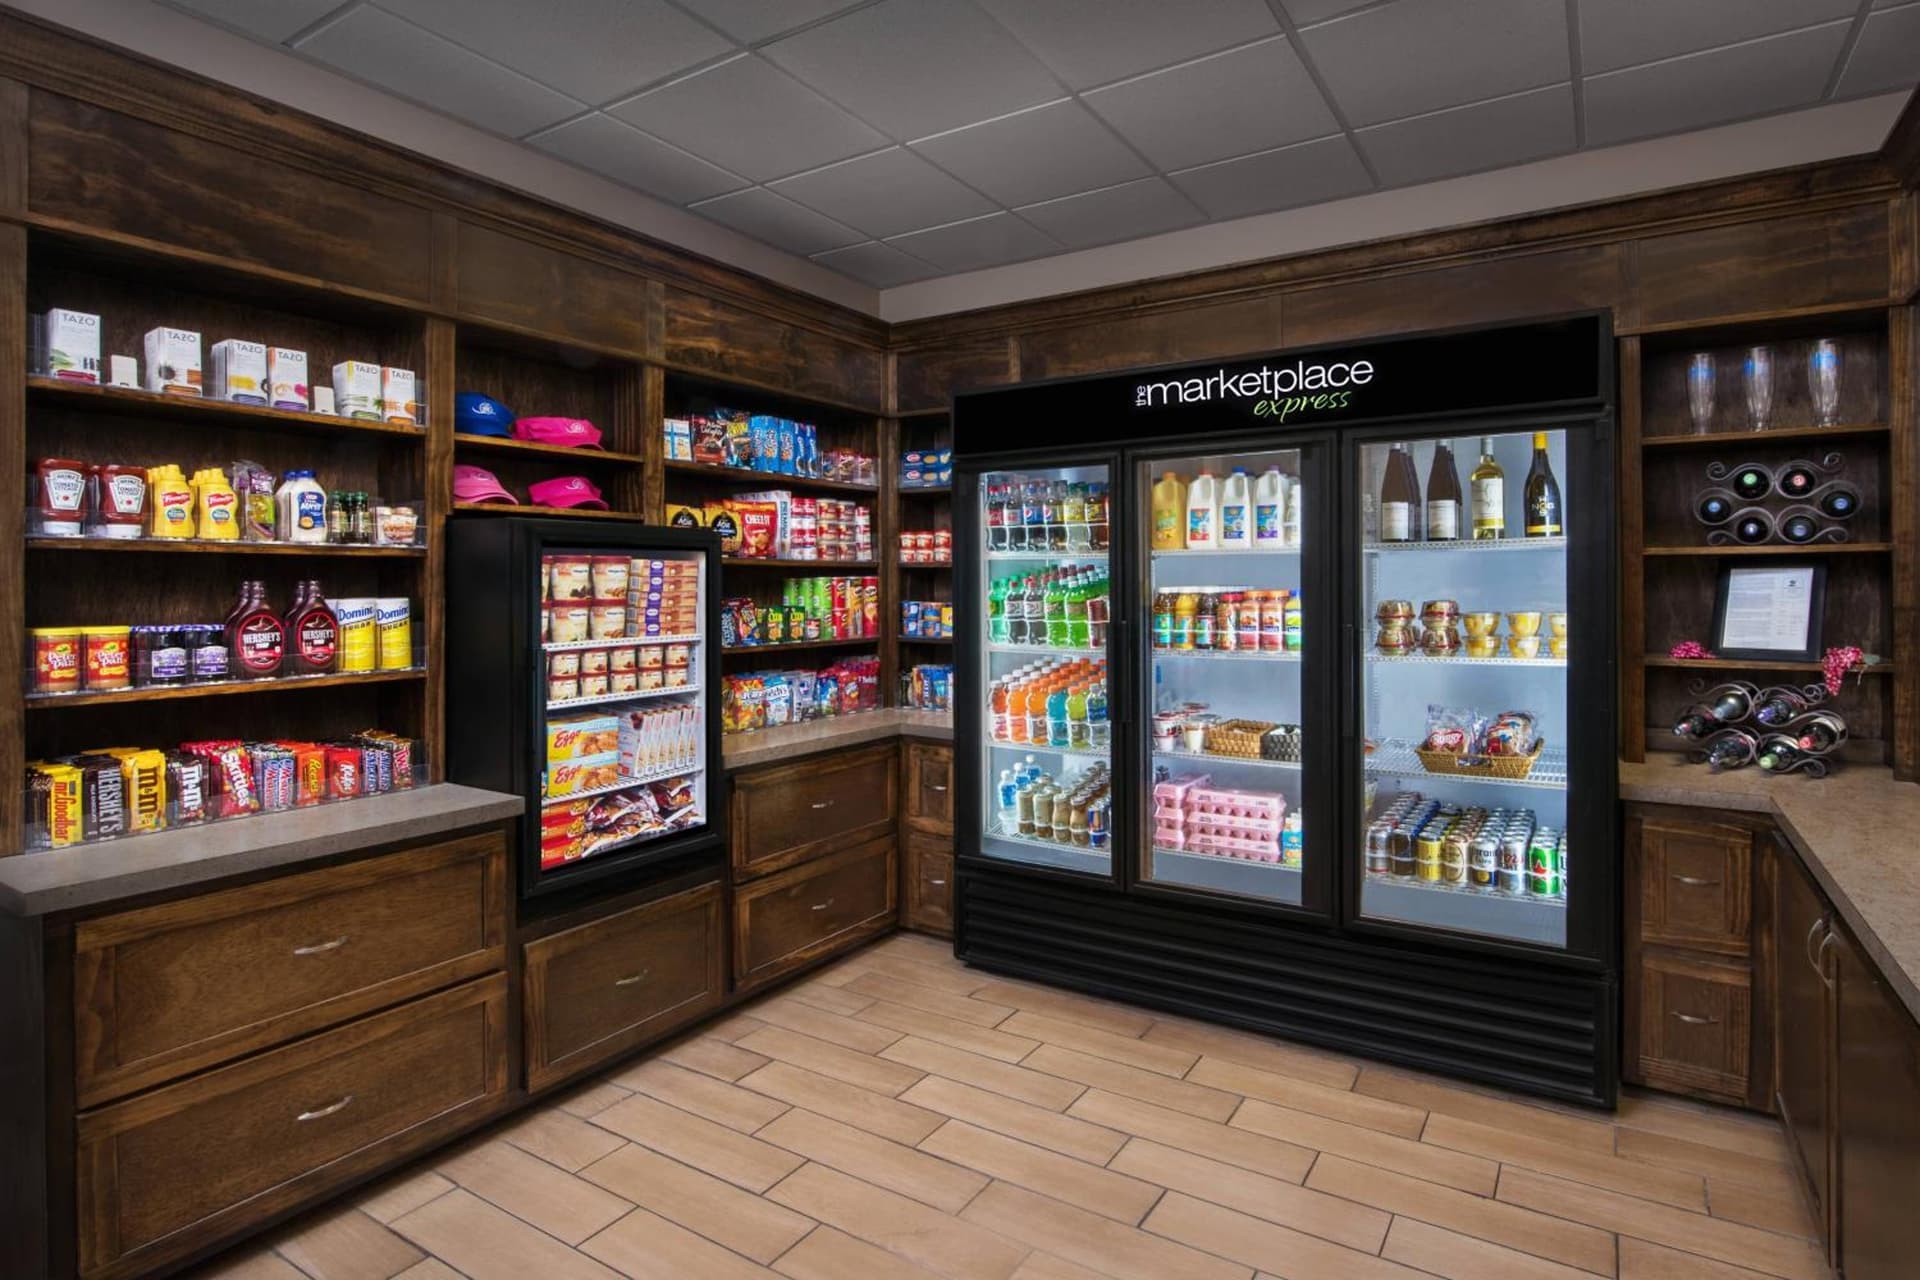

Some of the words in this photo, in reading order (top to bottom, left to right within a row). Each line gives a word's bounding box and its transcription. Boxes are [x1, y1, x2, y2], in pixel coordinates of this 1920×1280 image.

[63, 313, 96, 327] TAZO
[167, 331, 198, 343] TAZO
[236, 343, 264, 354] TAZO
[278, 352, 304, 362] TAZO
[355, 365, 378, 375] TAZO
[391, 370, 413, 380] TAZO
[1135, 385, 1148, 406] the
[1146, 360, 1374, 406] marketplace
[1253, 390, 1352, 423] express
[243, 631, 281, 645] HERSHEY'S
[302, 629, 335, 641] HERSHEY'S
[554, 730, 582, 748] Eggo
[223, 752, 250, 807] Skittles
[554, 764, 583, 784] Eggo
[98, 768, 122, 834] HERSHEY'S
